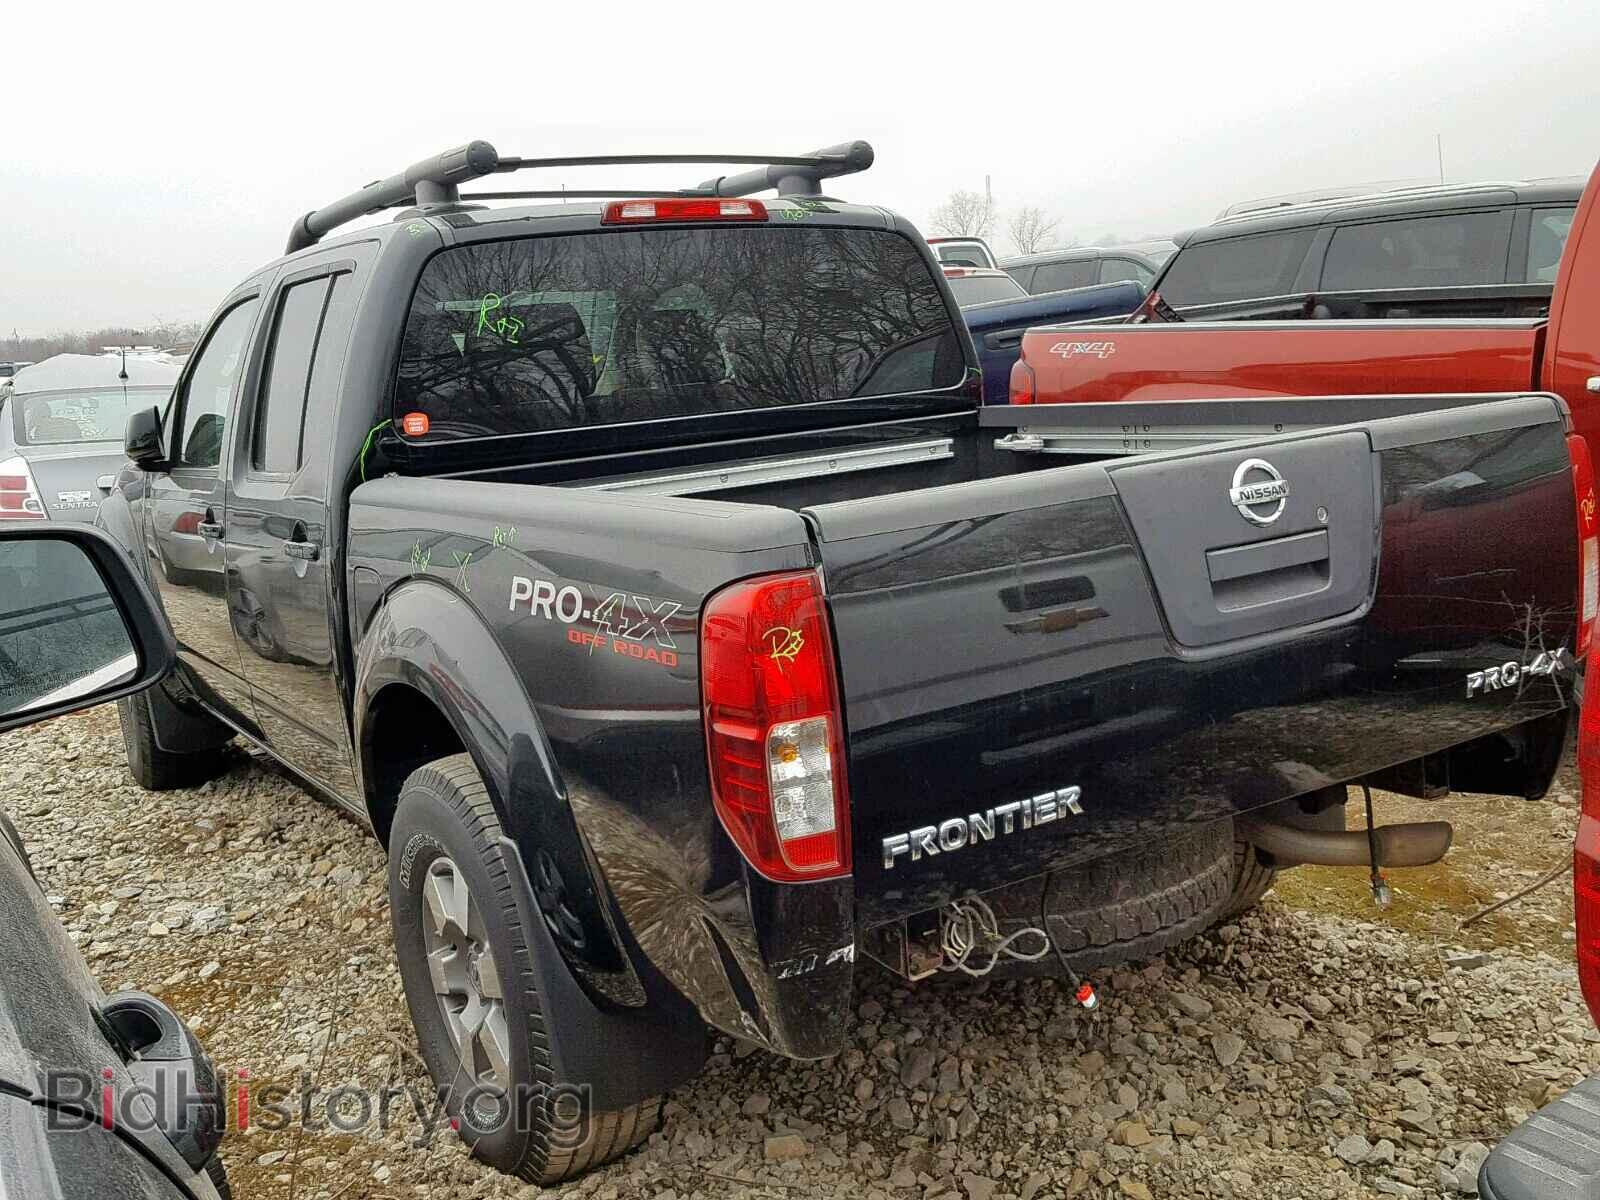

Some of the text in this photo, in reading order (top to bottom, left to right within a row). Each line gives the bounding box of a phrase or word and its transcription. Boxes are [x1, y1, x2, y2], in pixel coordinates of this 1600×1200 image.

[51, 501, 98, 511] SENTRA
[1239, 484, 1287, 501] NISSAN
[509, 575, 682, 649] PRO-4X
[567, 629, 679, 667] OFF ROAD
[1466, 646, 1568, 698] PRO-4X
[881, 785, 1085, 869] FRONTIER
